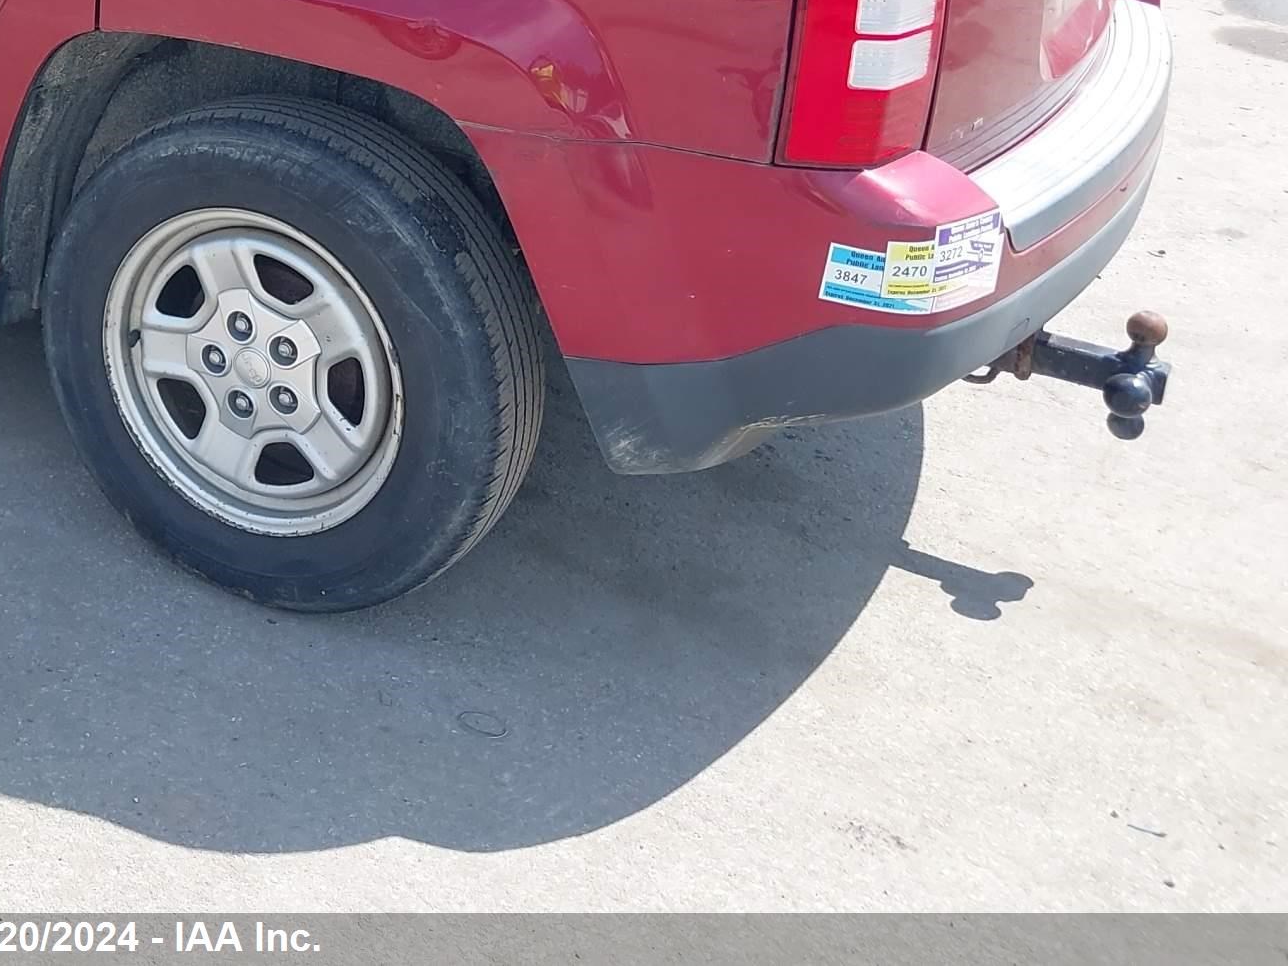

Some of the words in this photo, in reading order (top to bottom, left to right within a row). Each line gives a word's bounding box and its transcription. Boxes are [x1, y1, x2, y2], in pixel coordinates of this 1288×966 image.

[939, 245, 963, 262] 3272
[834, 269, 868, 285] 3847
[892, 265, 928, 277] 2470
